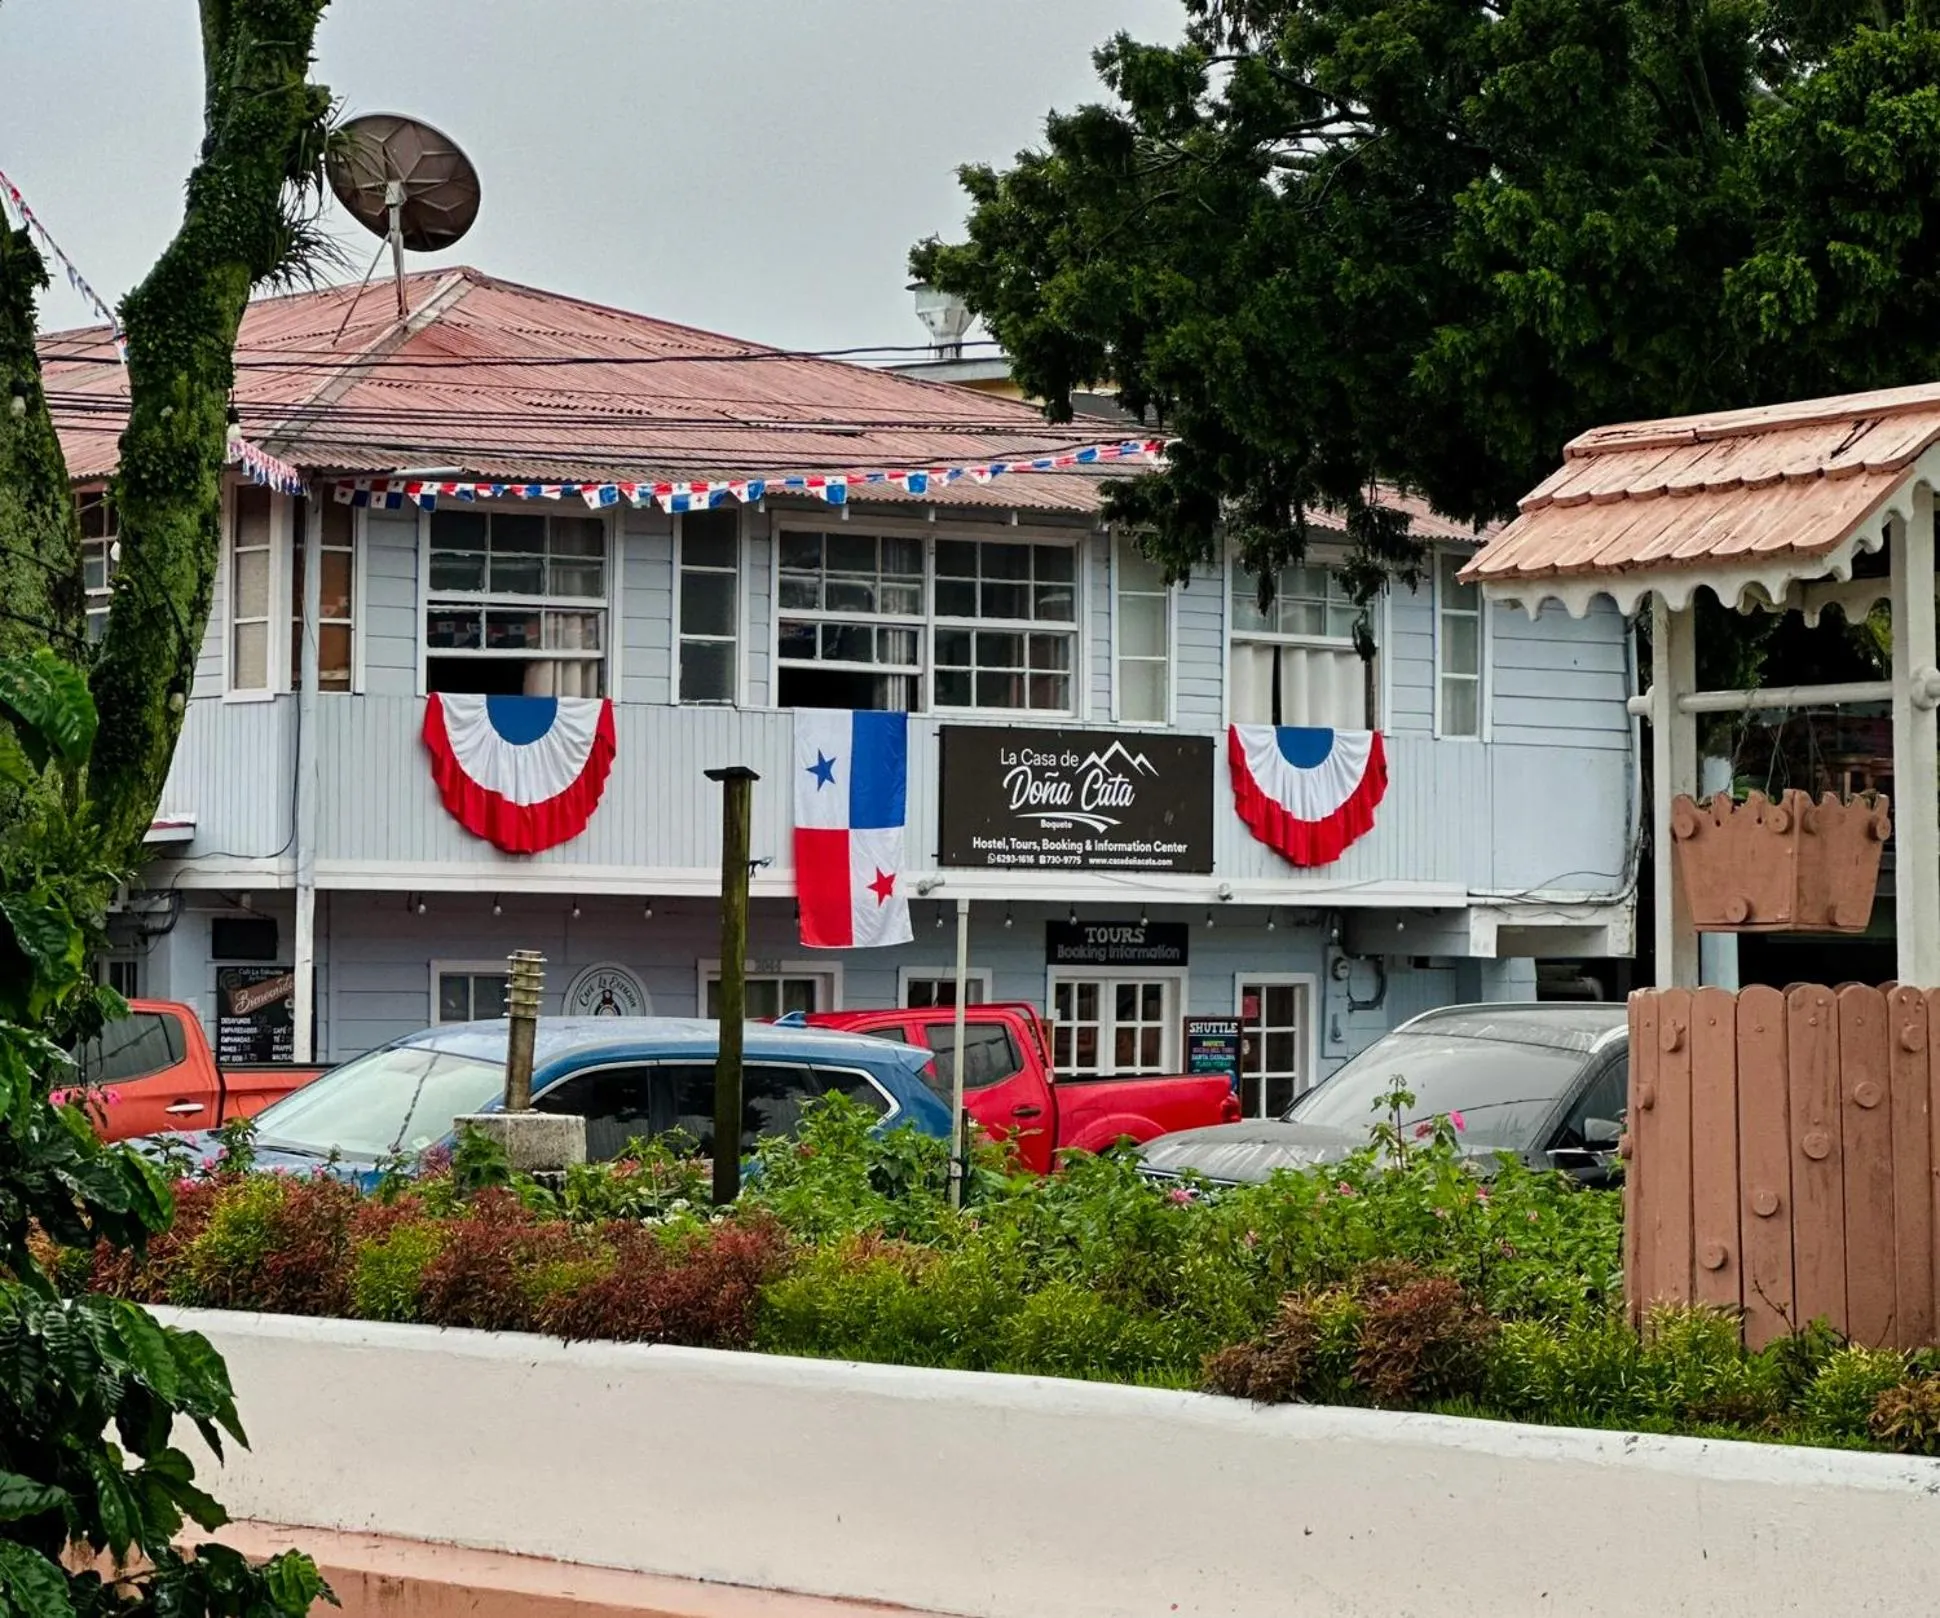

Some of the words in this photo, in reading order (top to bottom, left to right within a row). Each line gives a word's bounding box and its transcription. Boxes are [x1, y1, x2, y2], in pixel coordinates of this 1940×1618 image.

[1000, 747, 1018, 766] La
[1020, 748, 1057, 767] Casa
[1060, 749, 1080, 768] de
[1002, 764, 1074, 811] Doña
[1080, 766, 1136, 812] Cata
[972, 836, 1009, 850] Hostel,
[1009, 837, 1041, 852] Tours,
[1041, 838, 1083, 853] Booking
[1084, 840, 1092, 851] &
[1094, 840, 1151, 852] Information
[1153, 841, 1188, 854] Center
[1085, 927, 1145, 943] TOURS
[1057, 944, 1107, 961] Booking
[1108, 945, 1180, 959] Information
[1189, 1022, 1238, 1033] SHUTTLE
